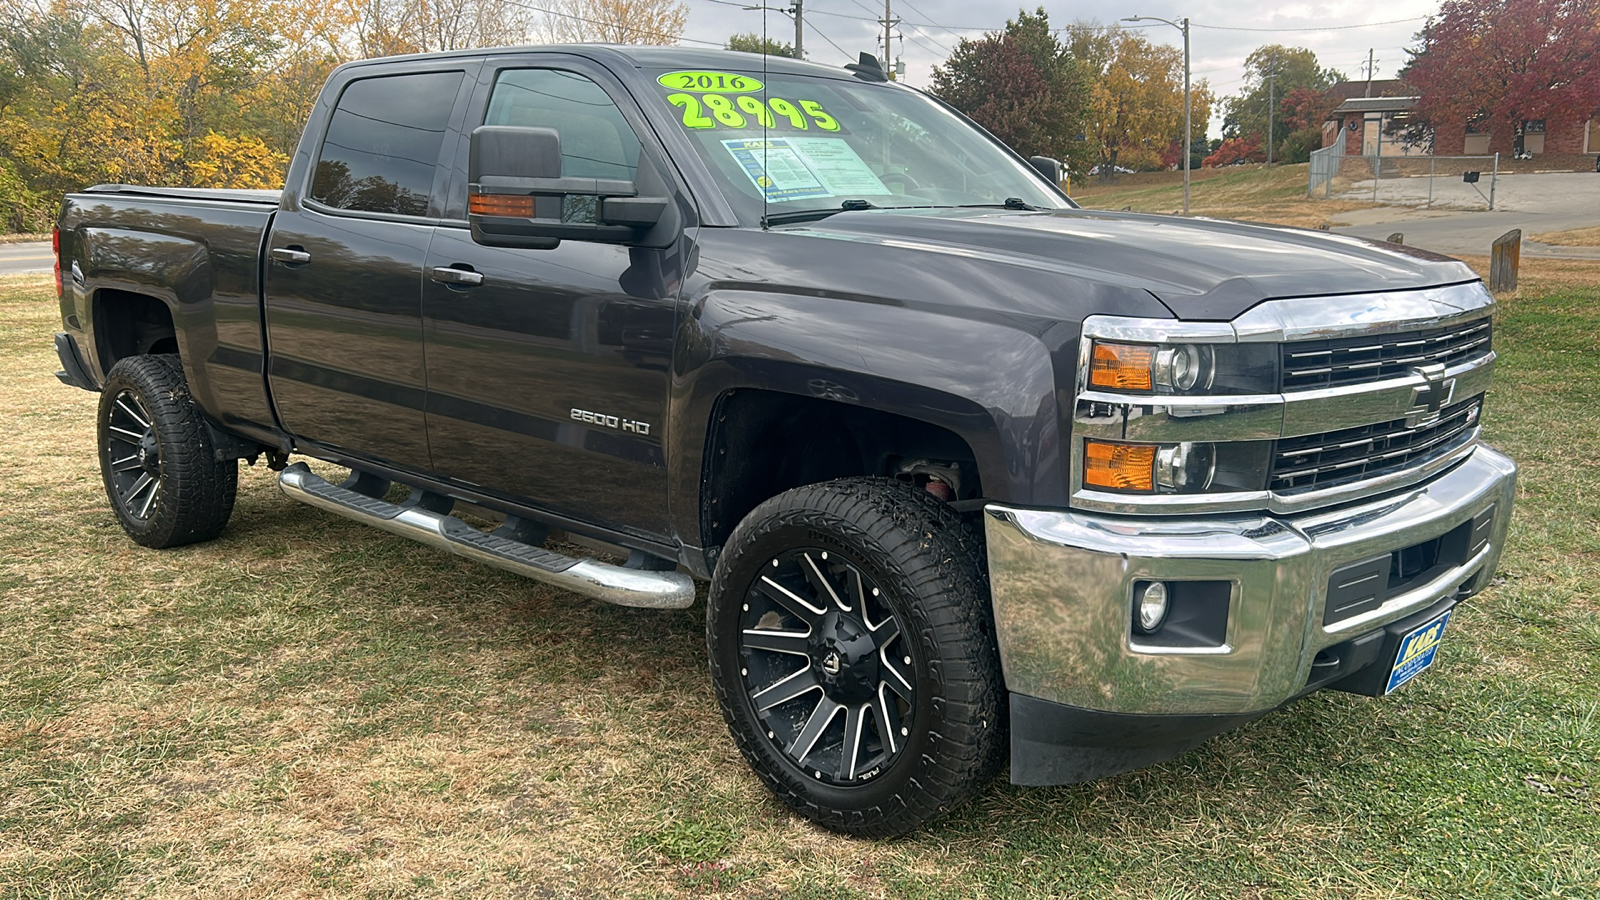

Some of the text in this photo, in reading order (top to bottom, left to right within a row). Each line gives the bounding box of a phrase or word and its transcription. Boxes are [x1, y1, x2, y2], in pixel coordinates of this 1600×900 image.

[680, 75, 745, 89] 2016
[667, 93, 841, 132] 28995
[570, 408, 651, 435] 2500 HD
